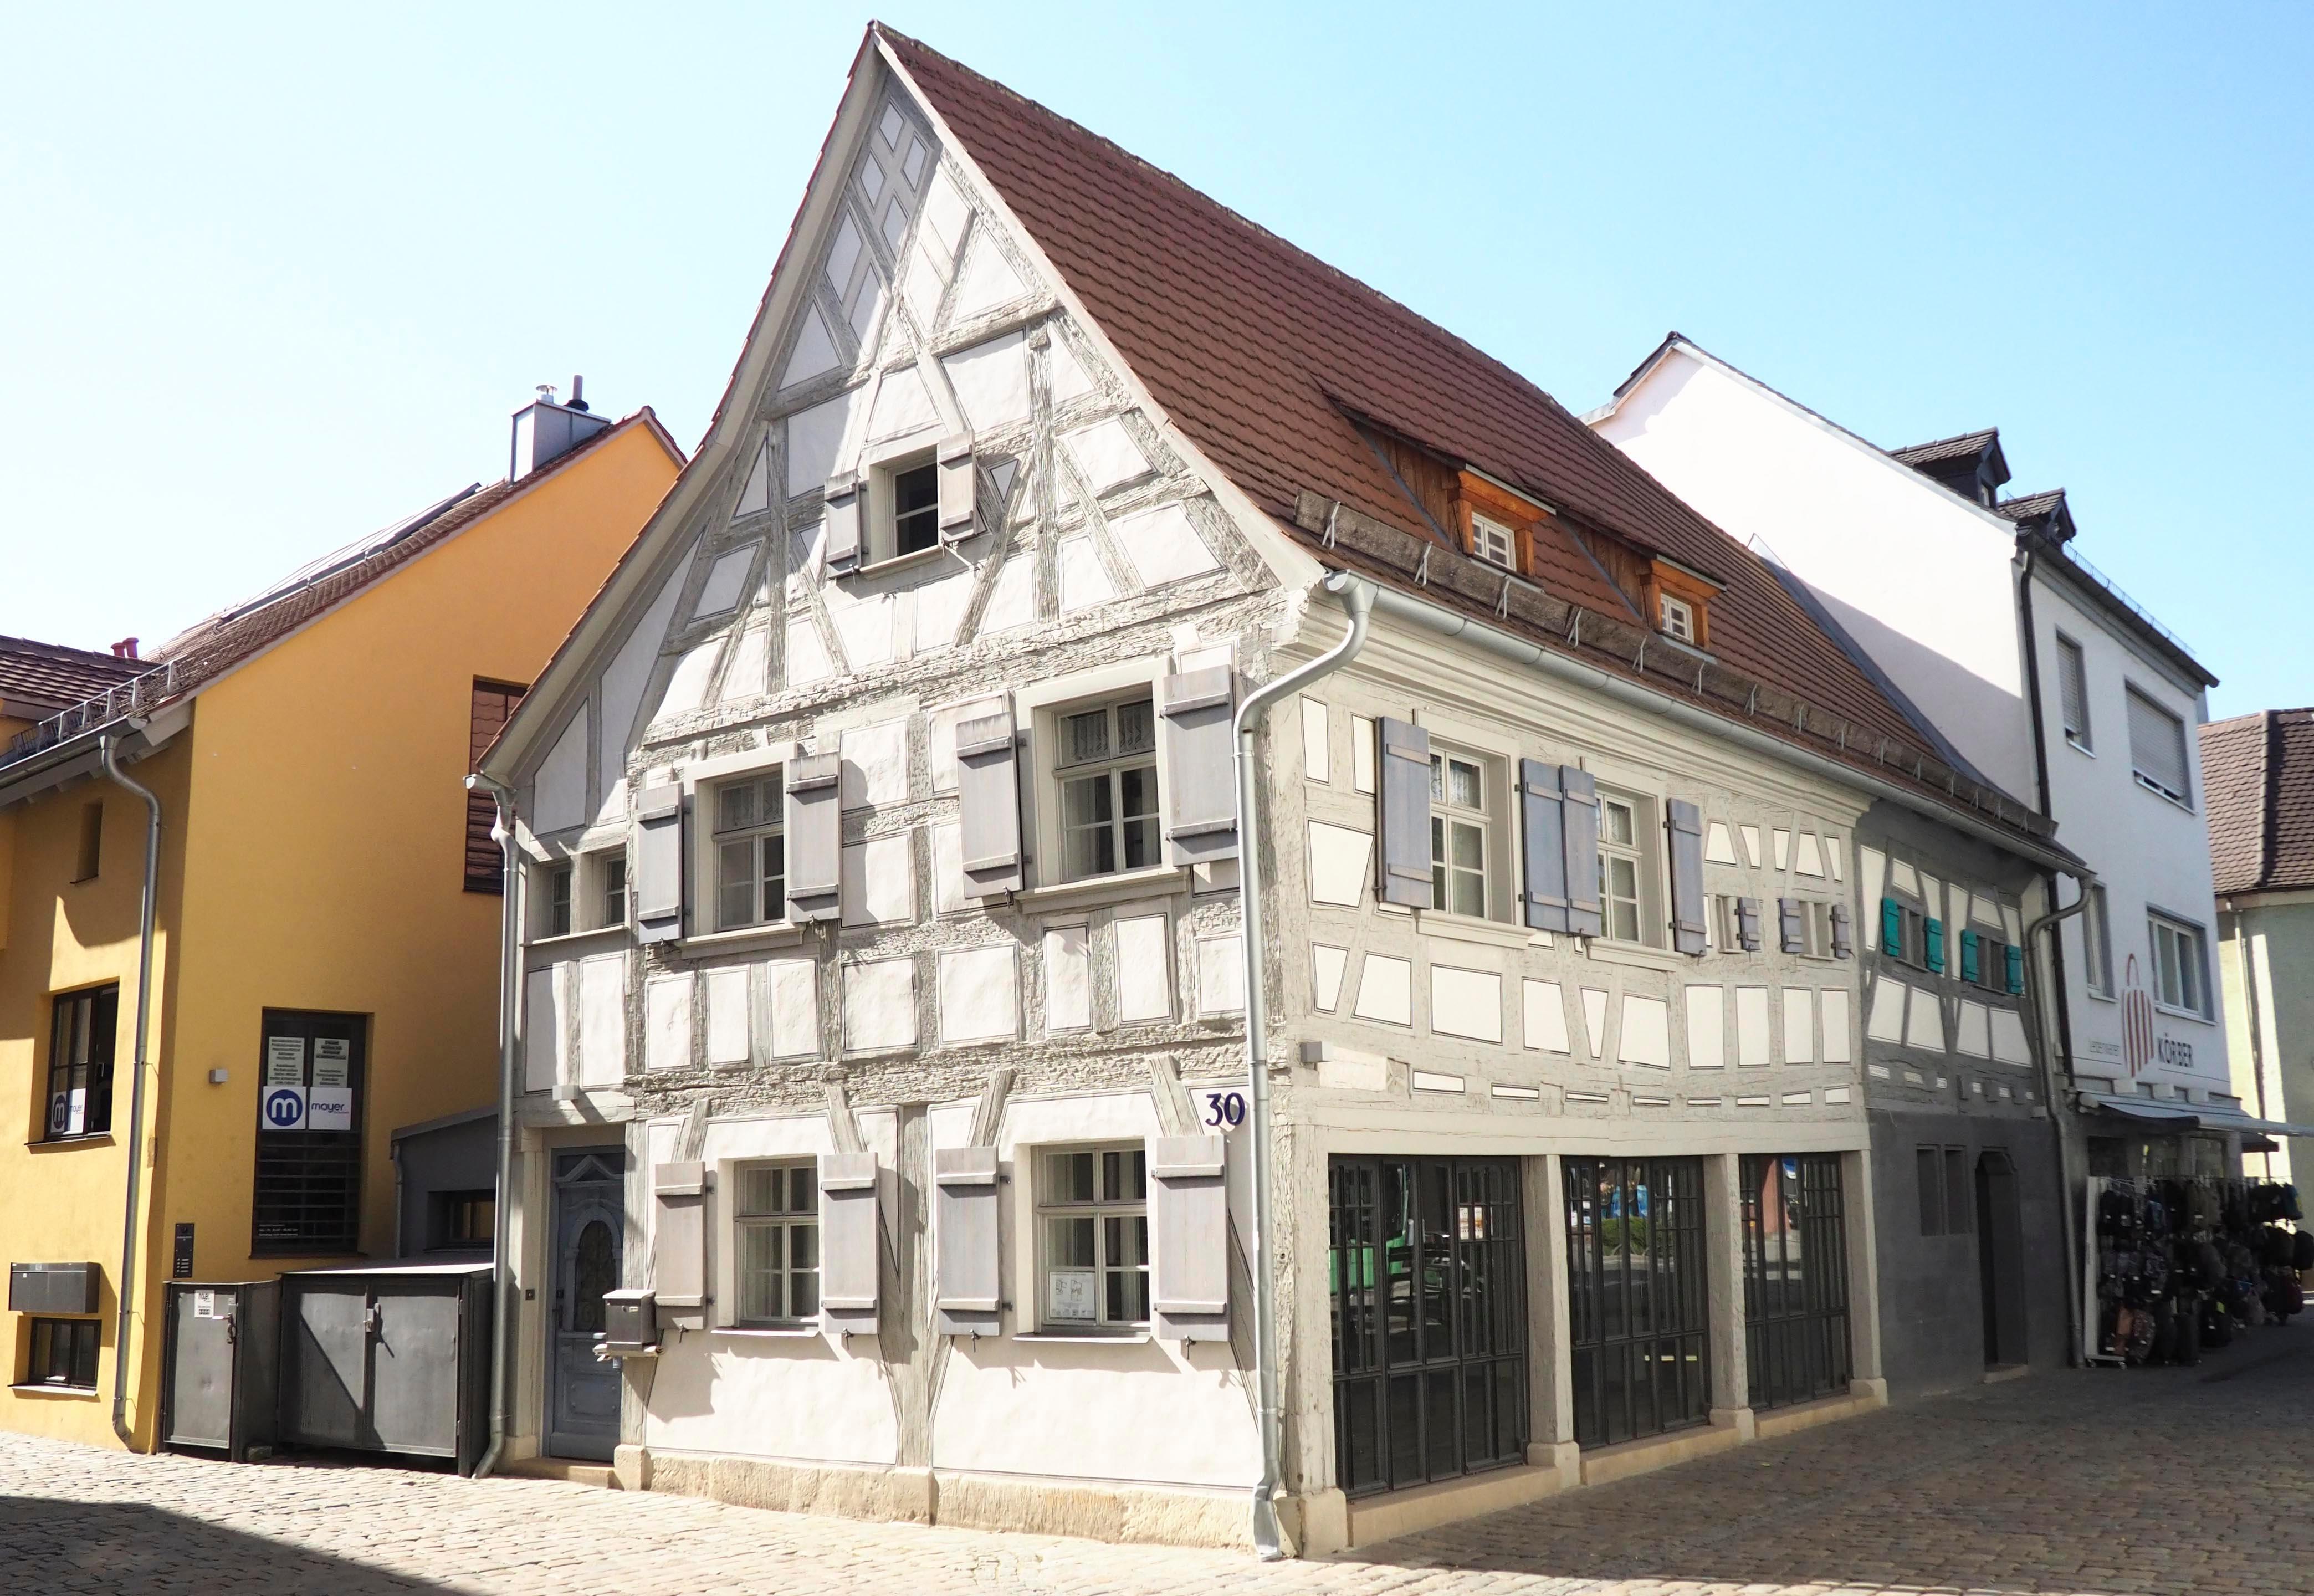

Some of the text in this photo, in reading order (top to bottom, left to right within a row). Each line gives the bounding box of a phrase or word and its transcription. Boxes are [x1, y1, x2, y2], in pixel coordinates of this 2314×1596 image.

[2157, 1032, 2194, 1068] KÖRBER
[311, 1103, 345, 1113] mayer
[1205, 1092, 1245, 1126] 30
